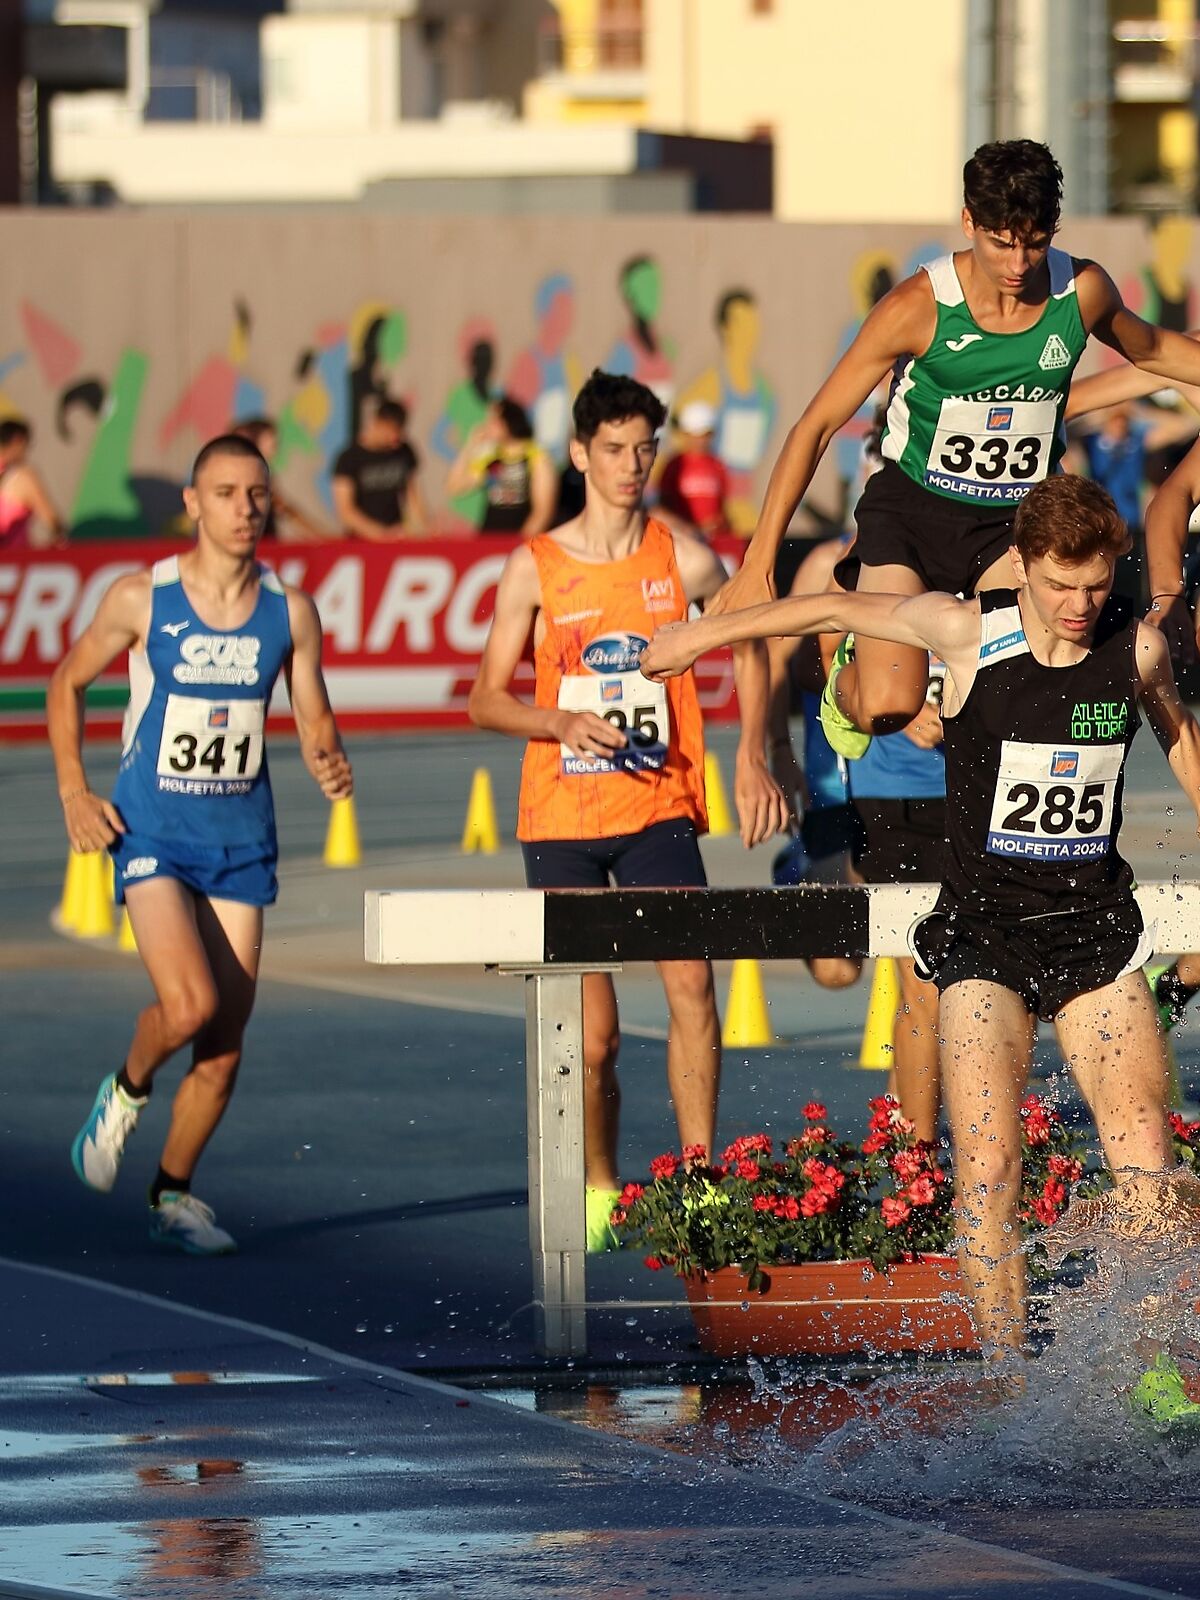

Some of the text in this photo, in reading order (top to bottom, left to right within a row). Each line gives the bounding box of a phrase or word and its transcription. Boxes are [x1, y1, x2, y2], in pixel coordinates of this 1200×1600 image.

[940, 435, 1041, 480] 333
[928, 475, 1031, 499] MOLFETTA 202
[1072, 702, 1128, 721] ATLETICA
[170, 734, 251, 775] 341
[565, 755, 617, 772] MOLFE
[158, 777, 224, 796] MOLFETTA
[1001, 783, 1105, 835] 285
[991, 838, 1105, 856] MOLFETTA 2024
